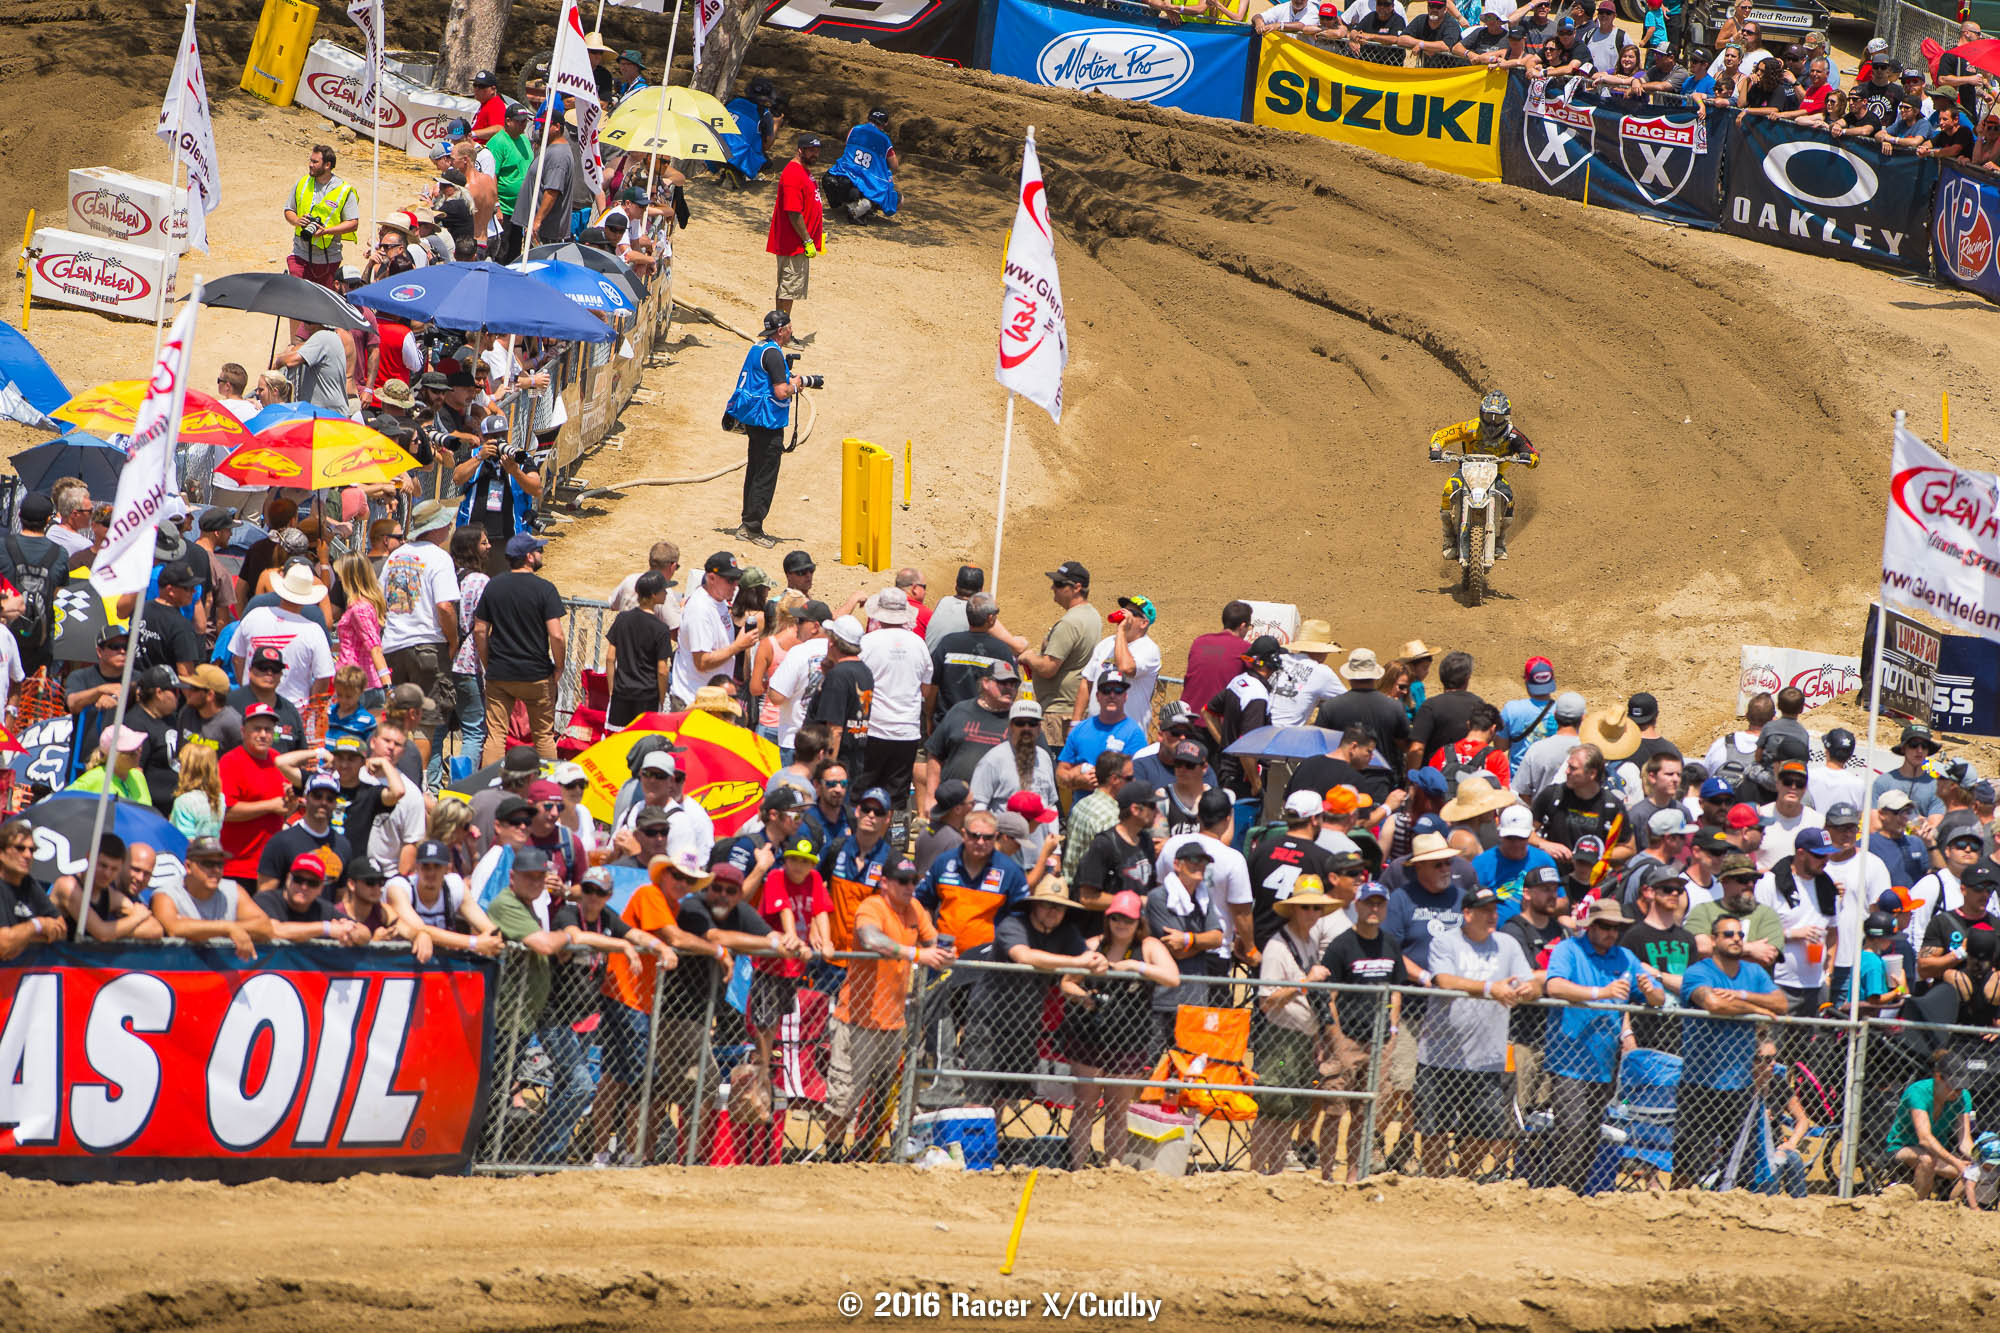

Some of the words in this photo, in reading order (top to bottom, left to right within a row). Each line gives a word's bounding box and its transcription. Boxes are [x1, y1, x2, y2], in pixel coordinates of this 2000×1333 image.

[1749, 9, 1773, 21] nited
[1775, 13, 1808, 24] Rentals
[1054, 37, 1123, 85] Motion
[1124, 44, 1172, 77] Pro
[710, 117, 724, 128] G
[1265, 69, 1495, 146] SUZUKI
[607, 129, 627, 141] G
[691, 143, 709, 155] G
[1537, 121, 1577, 167] X
[1625, 123, 1691, 143] RACER
[854, 149, 872, 169] 28
[1639, 143, 1674, 188] X
[1733, 196, 1904, 256] OAKLEY
[1960, 236, 1991, 264] Racing
[52, 256, 92, 283] GLEN
[94, 260, 135, 294] HELEN
[1921, 471, 1980, 530] GLEN
[1803, 669, 1834, 698] GLEN
[1262, 864, 1303, 900] 4
[0, 972, 176, 1155] AS
[206, 971, 425, 1153] OIL
